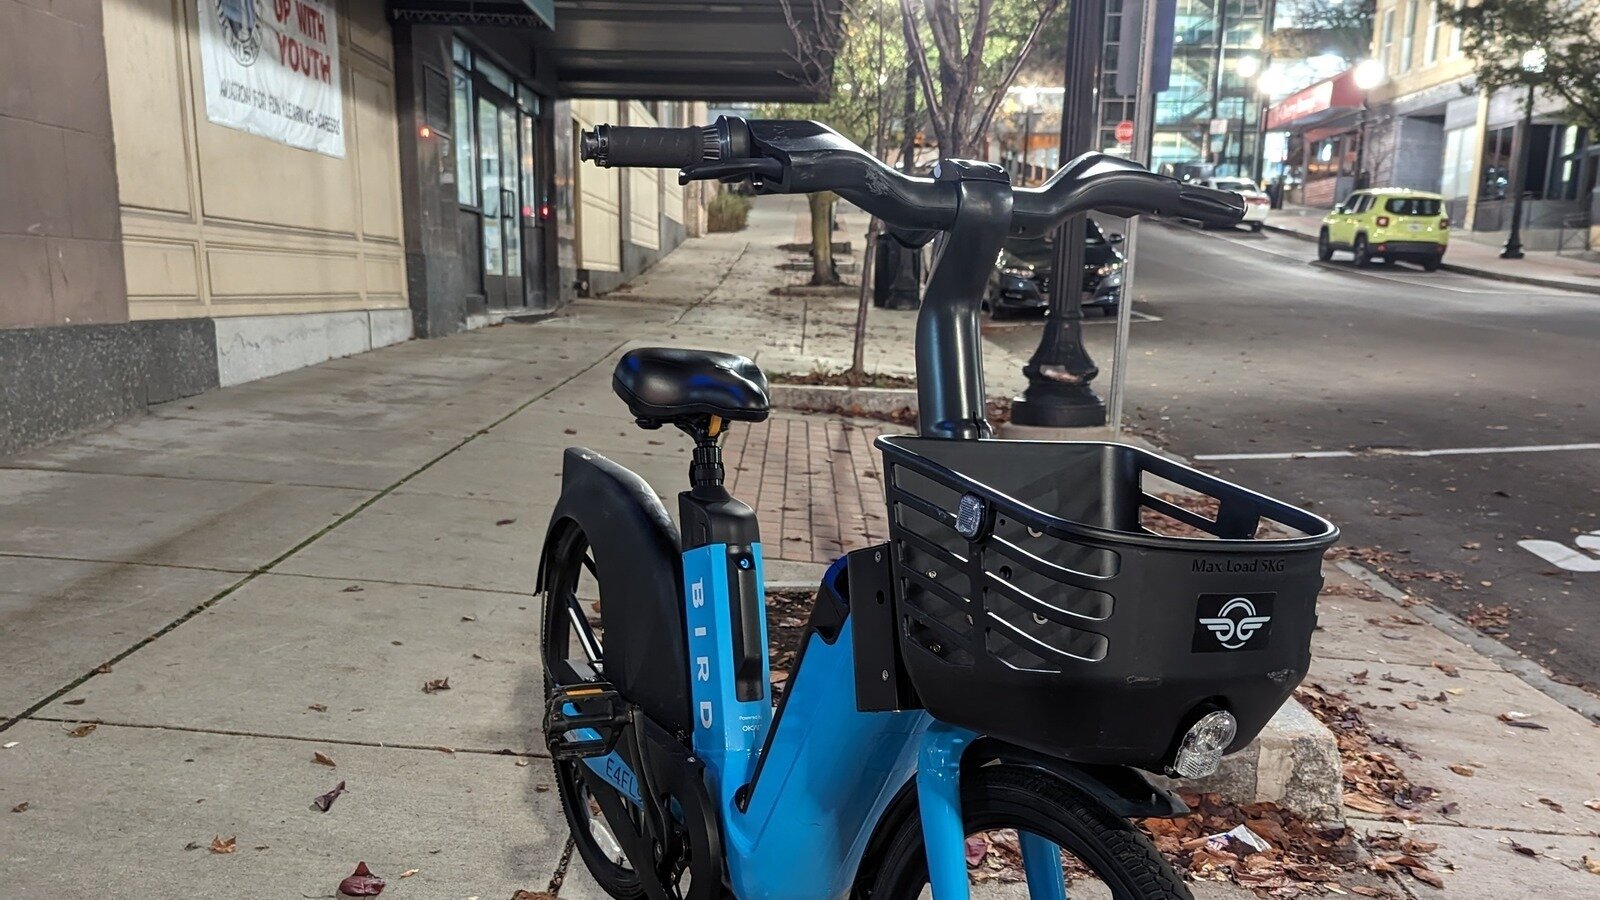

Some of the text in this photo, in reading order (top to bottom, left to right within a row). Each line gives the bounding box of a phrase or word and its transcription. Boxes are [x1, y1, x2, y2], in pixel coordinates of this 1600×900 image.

[273, 0, 291, 25] UP
[295, 0, 327, 45] WITH
[276, 31, 332, 85] YOUTH
[1192, 559, 1222, 573] Max
[1226, 559, 1258, 573] Load
[691, 576, 713, 730] BIRD
